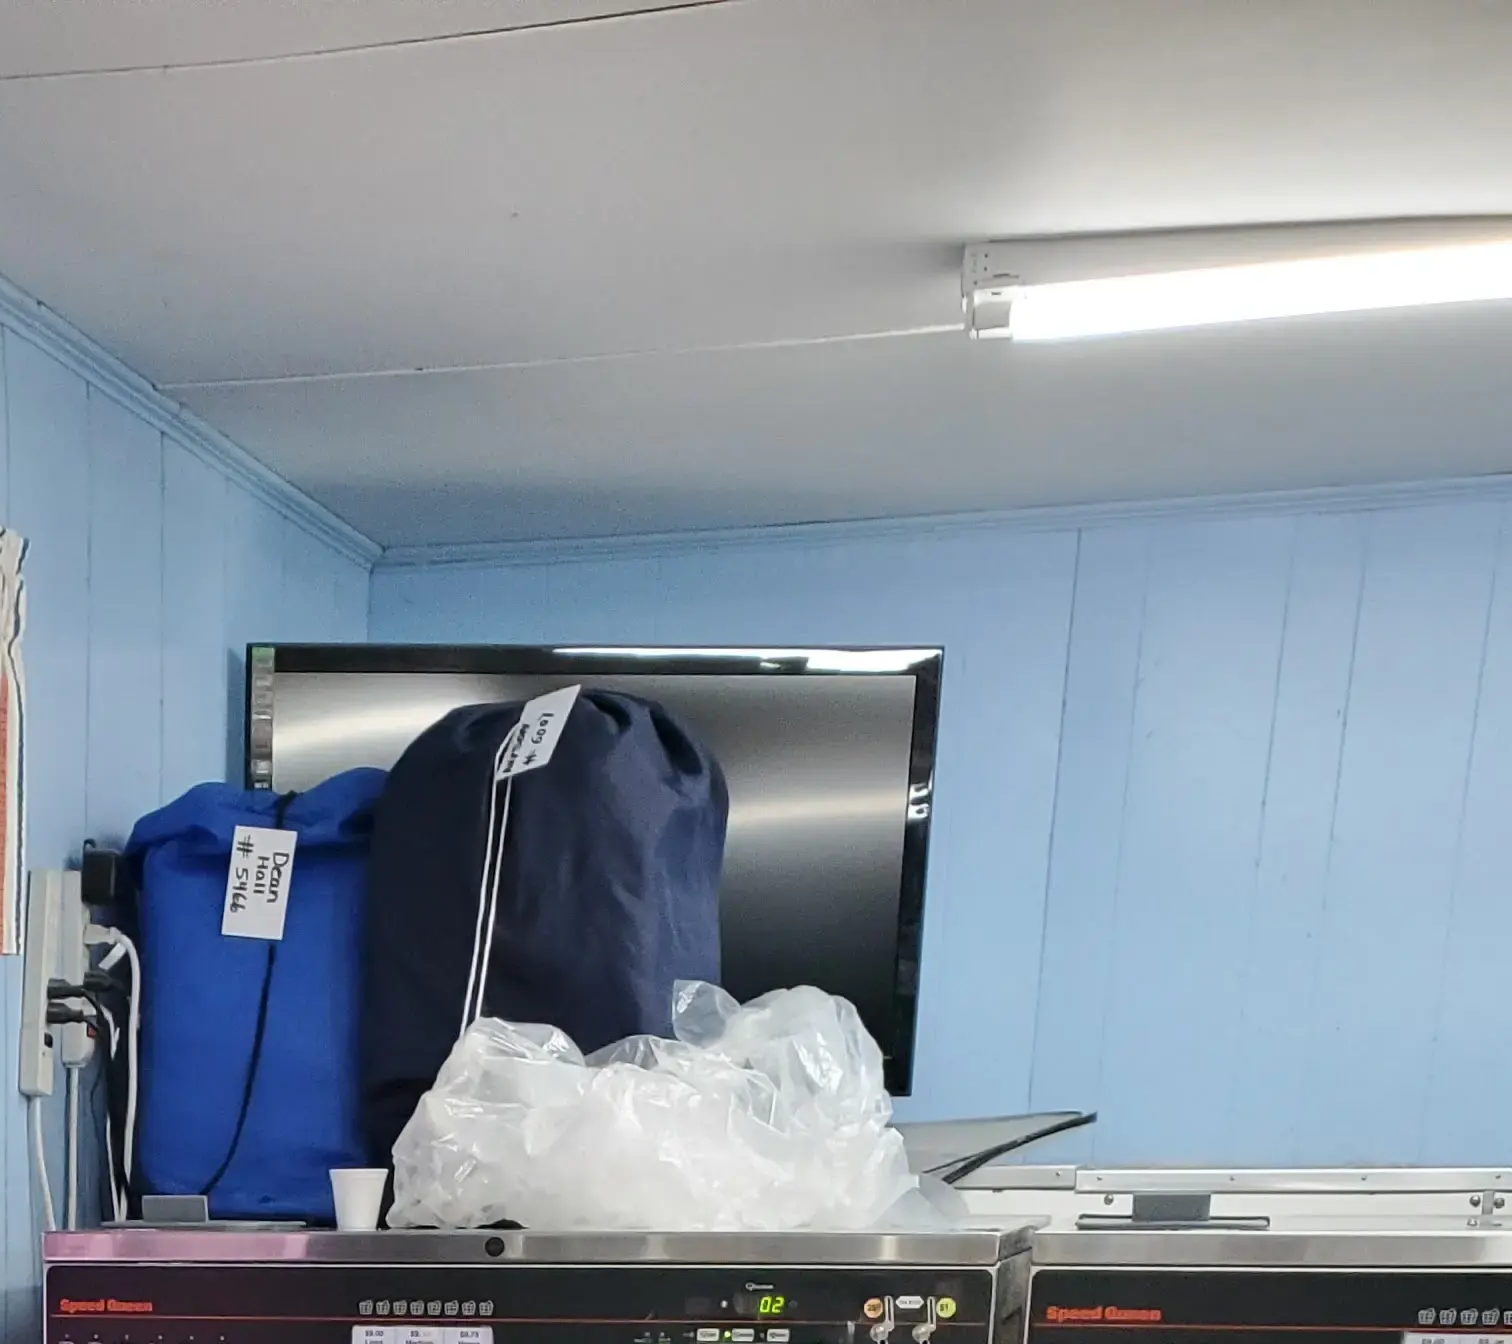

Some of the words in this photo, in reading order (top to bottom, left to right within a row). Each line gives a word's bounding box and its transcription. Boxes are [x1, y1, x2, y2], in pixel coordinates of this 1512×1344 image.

[253, 856, 270, 894] Hall
[266, 852, 290, 903] Dean
[60, 1299, 105, 1313] Speed
[1046, 1306, 1102, 1322] Speed
